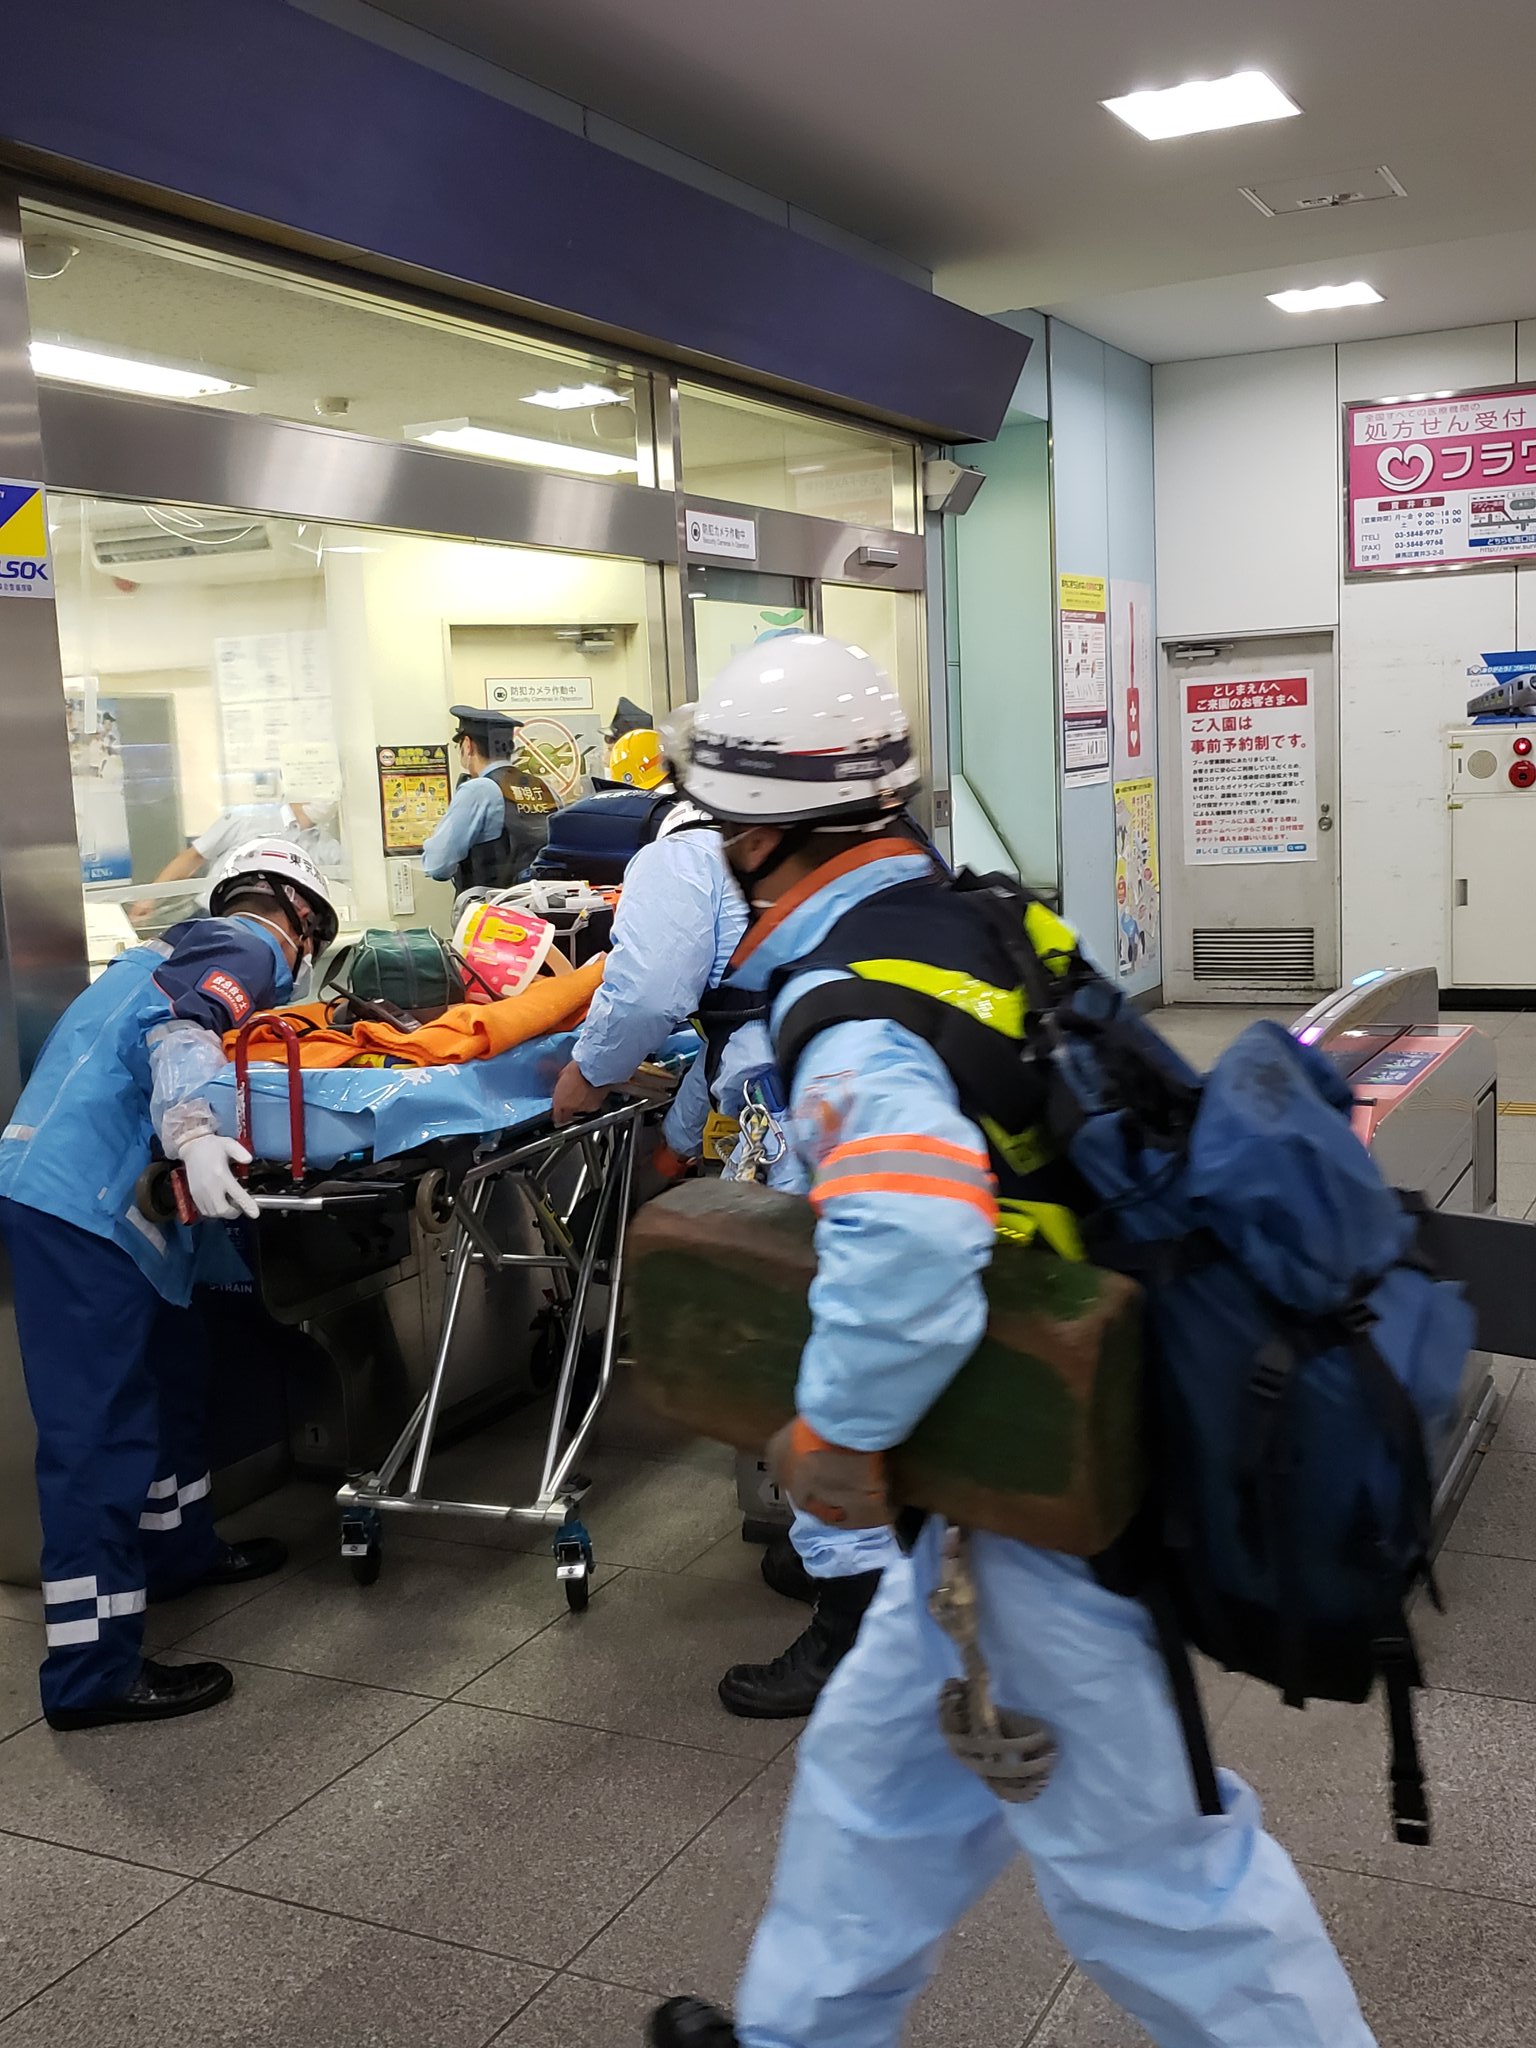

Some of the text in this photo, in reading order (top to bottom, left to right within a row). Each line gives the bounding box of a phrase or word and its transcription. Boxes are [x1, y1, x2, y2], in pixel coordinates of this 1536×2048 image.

[1365, 403, 1481, 423] 全国すべての医療機関の
[1365, 408, 1527, 442] 処方せん受付
[1395, 529, 1443, 539] 03-5848-9767
[1395, 539, 1444, 549] 03-5848-9768
[510, 686, 577, 696] 防犯カメラ作動中
[1213, 682, 1281, 697] としまえんへ
[1197, 694, 1299, 711] ご来園のお客さまへ
[1191, 716, 1253, 733] ご入園は
[1190, 734, 1307, 755] 事前予約制です。
[510, 785, 543, 801] 警視庁
[516, 803, 549, 814] POLICE
